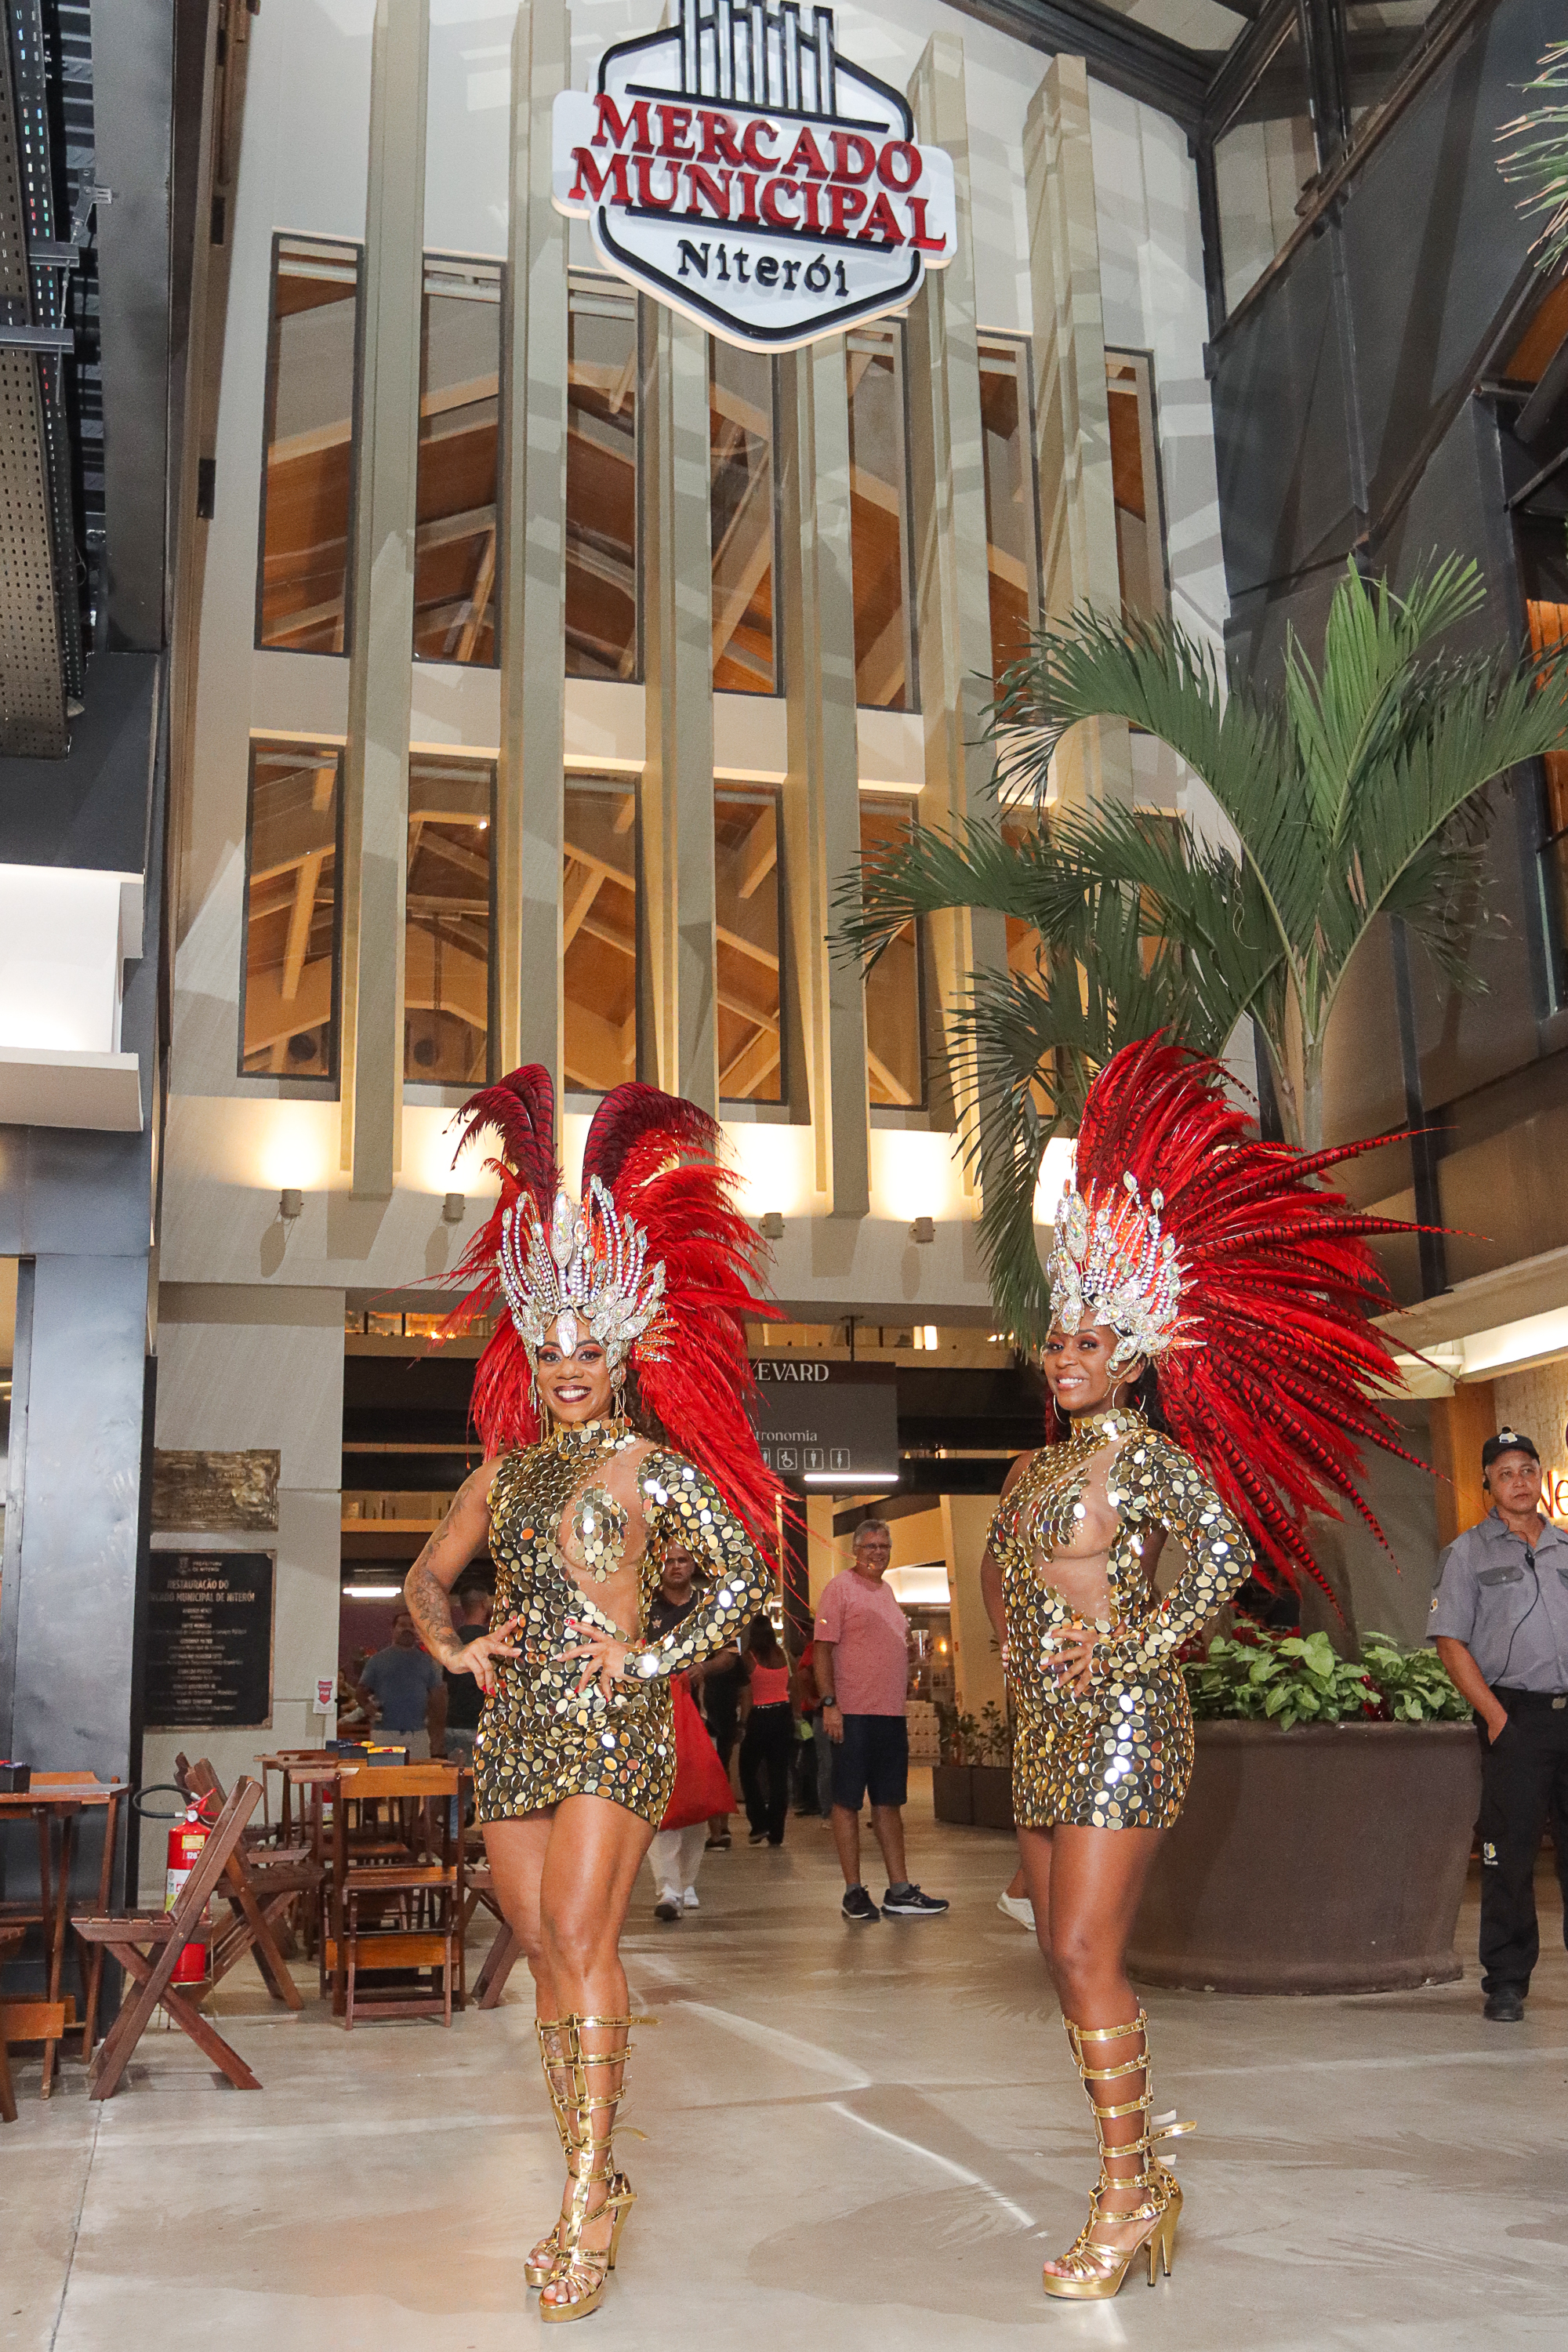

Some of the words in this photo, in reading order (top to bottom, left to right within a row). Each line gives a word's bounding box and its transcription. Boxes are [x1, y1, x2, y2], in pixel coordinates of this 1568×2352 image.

[590, 93, 923, 193] MERCADO
[568, 147, 947, 251] MUNICIPAL
[677, 238, 850, 297] Niterói
[754, 1363, 829, 1381] EVARD
[167, 1578, 217, 1591] RESTAURAÇÃO
[219, 1580, 230, 1590] DO
[176, 1592, 214, 1602] MUNICIPAL
[216, 1592, 225, 1602] DE
